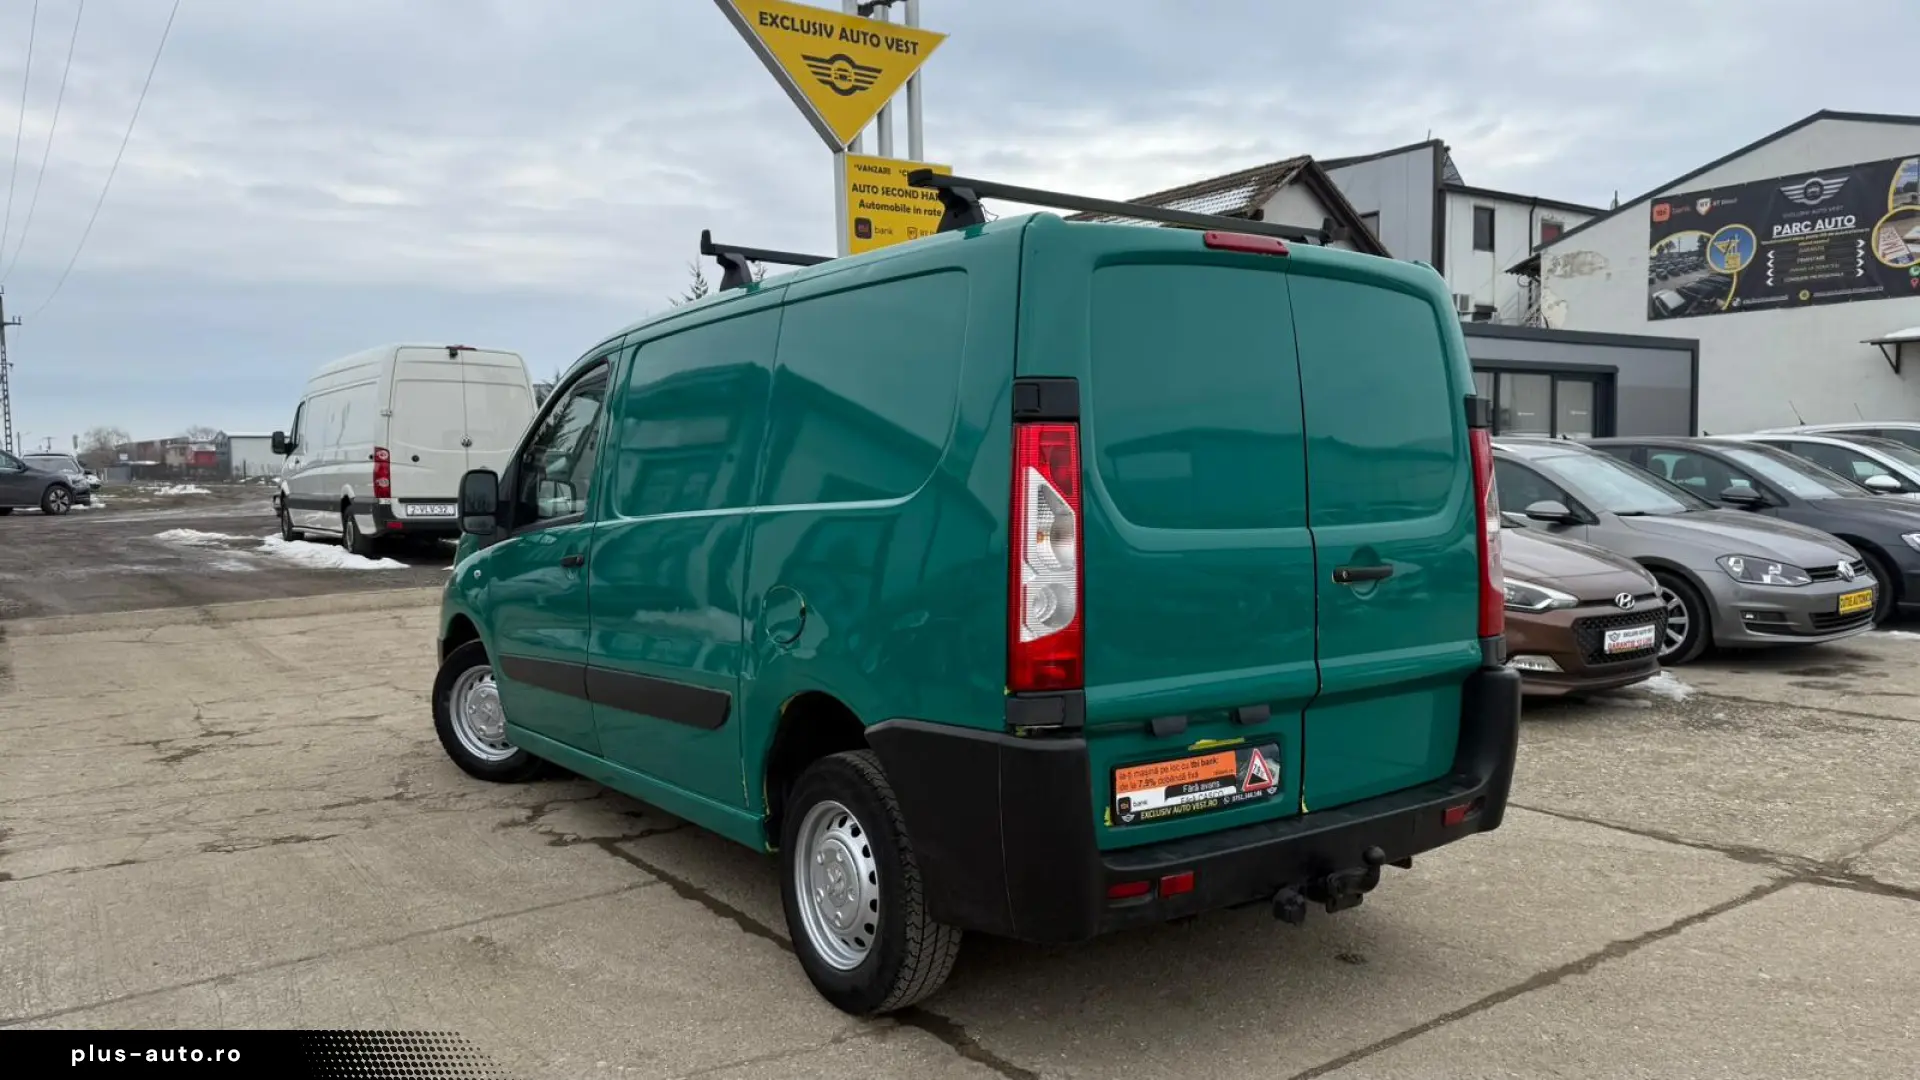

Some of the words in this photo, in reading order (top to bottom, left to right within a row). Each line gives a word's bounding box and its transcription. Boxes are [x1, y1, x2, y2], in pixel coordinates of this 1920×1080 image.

[759, 11, 834, 38] EXCLUSIV
[838, 26, 881, 49] AUTO
[885, 37, 919, 56] VEST
[851, 183, 879, 195] AUTO
[881, 187, 919, 200] SECOND
[858, 199, 911, 214] Automobile
[923, 208, 943, 217] rate
[1772, 220, 1812, 236] PARC
[1814, 215, 1856, 230] AUTO
[1140, 807, 1172, 820] EXCLUSIV
[1172, 803, 1192, 814] AUTO
